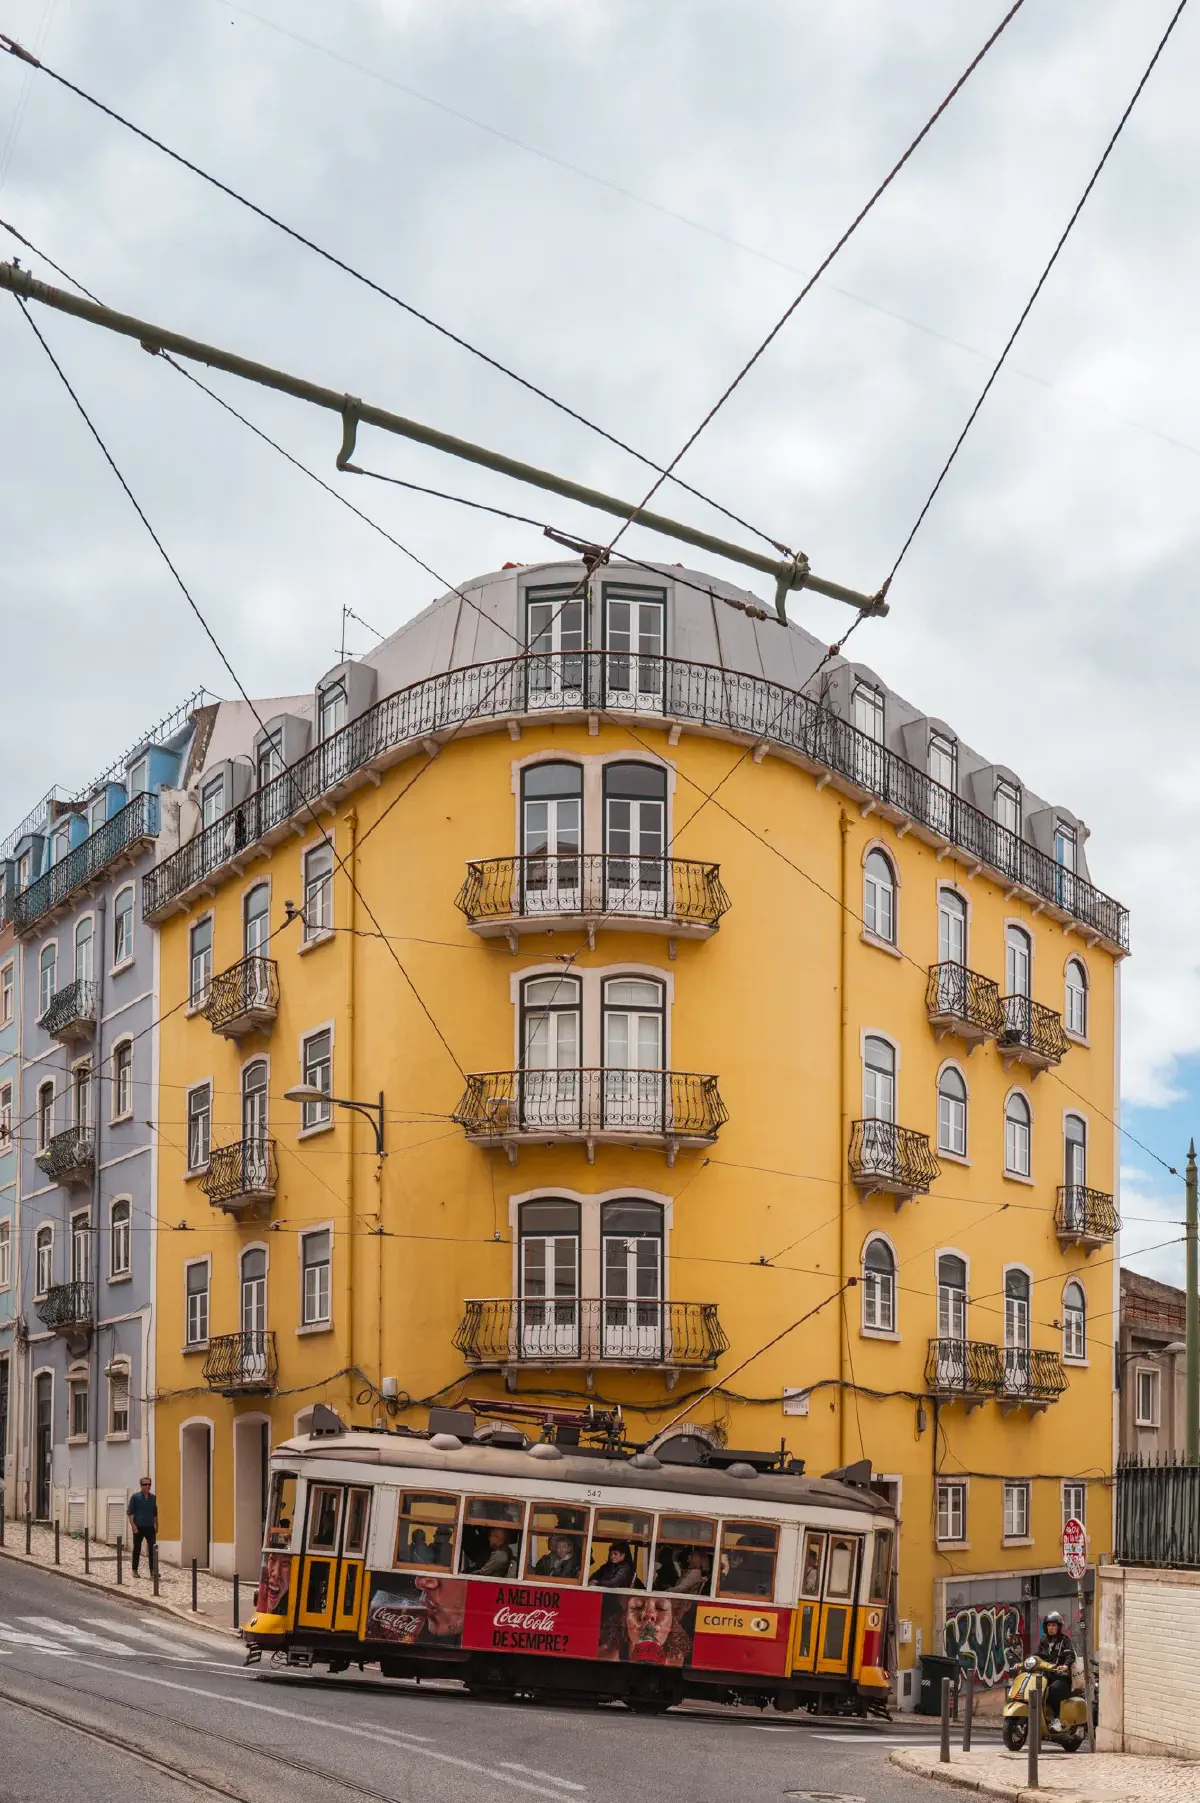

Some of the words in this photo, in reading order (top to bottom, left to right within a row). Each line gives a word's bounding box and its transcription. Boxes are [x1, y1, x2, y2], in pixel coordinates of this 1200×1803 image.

[587, 1489, 602, 1498] 542
[495, 1587, 505, 1605] A
[508, 1588, 561, 1608] MELHOR
[493, 1606, 560, 1631] Coca-Cola
[703, 1614, 744, 1628] carris
[492, 1629, 509, 1647] DE
[510, 1631, 569, 1652] SEMPRE?
